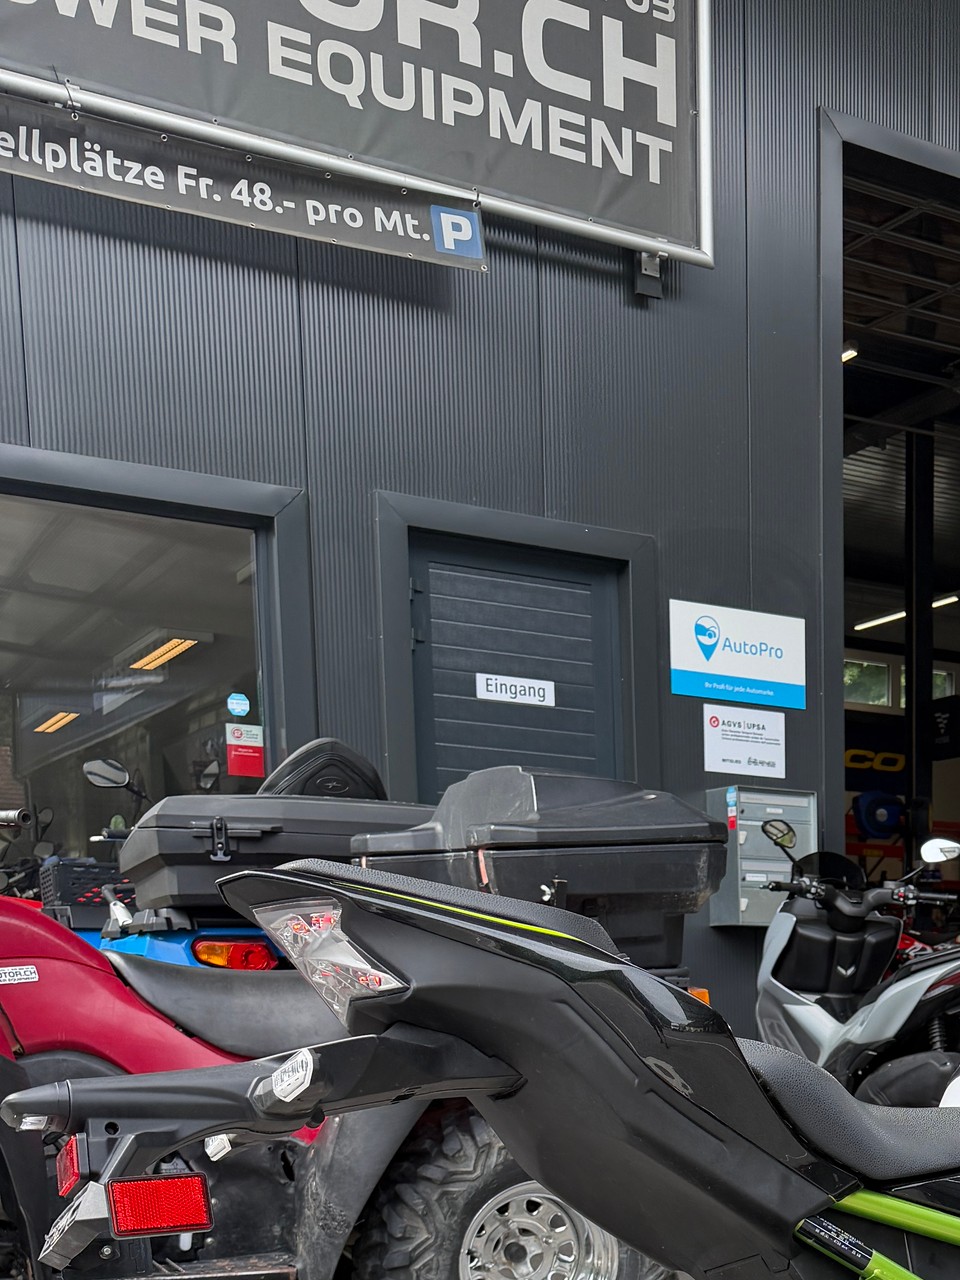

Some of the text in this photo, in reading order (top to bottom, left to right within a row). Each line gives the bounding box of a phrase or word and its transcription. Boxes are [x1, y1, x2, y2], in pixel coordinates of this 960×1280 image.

[267, 20, 673, 184] EQUIPMENT
[0, 125, 473, 250] ellplätze Fr. 48.- pro Mt. P
[721, 637, 784, 659] AutoPro
[485, 677, 546, 703] Eingang
[721, 719, 766, 731] AGVS UPSA
